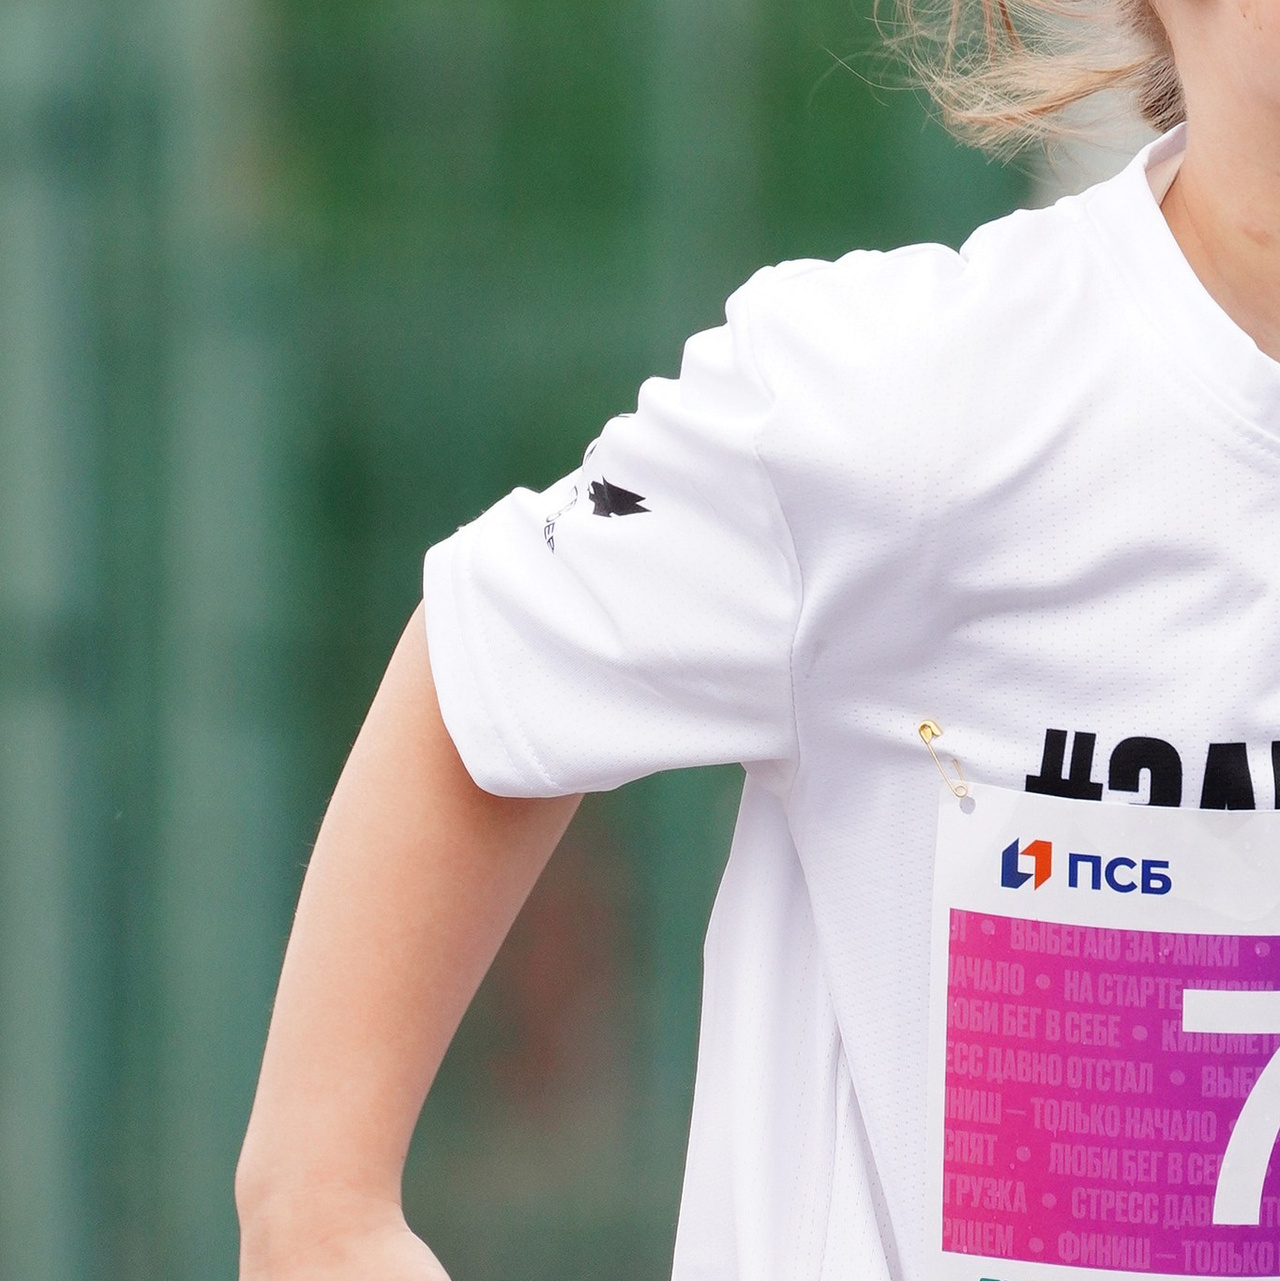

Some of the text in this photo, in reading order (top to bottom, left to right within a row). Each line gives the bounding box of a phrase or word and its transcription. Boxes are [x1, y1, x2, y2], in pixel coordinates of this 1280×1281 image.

[1067, 852, 1172, 896] ПСБ
[1010, 917, 1122, 962] ВЫБЕГАЮ
[1125, 930, 1154, 964] ЗА
[1158, 933, 1240, 967] РАМКИ
[949, 953, 1024, 996] АЧАЛО
[1064, 969, 1094, 1004] НА
[1098, 972, 1183, 1009] СТАРТЕ
[1002, 1003, 1042, 1039] БЕГ
[1045, 1008, 1061, 1042] В
[1064, 1011, 1122, 1048] СЕБЕ
[986, 1046, 1063, 1087] ДАВНО
[1066, 1055, 1154, 1094] ОТСТАЛ
[1030, 1096, 1121, 1138] ТОЛЬКО
[1125, 1106, 1217, 1142] НАЧАЛО
[1050, 1141, 1119, 1180] ЛЮБИ
[1122, 1148, 1164, 1183] БЕГ
[1167, 1151, 1183, 1186] В
[1071, 1186, 1160, 1225] СТРЕСС
[1057, 1229, 1151, 1270] ФИНИШ
[1181, 1239, 1275, 1274] ТОЛЬКО
